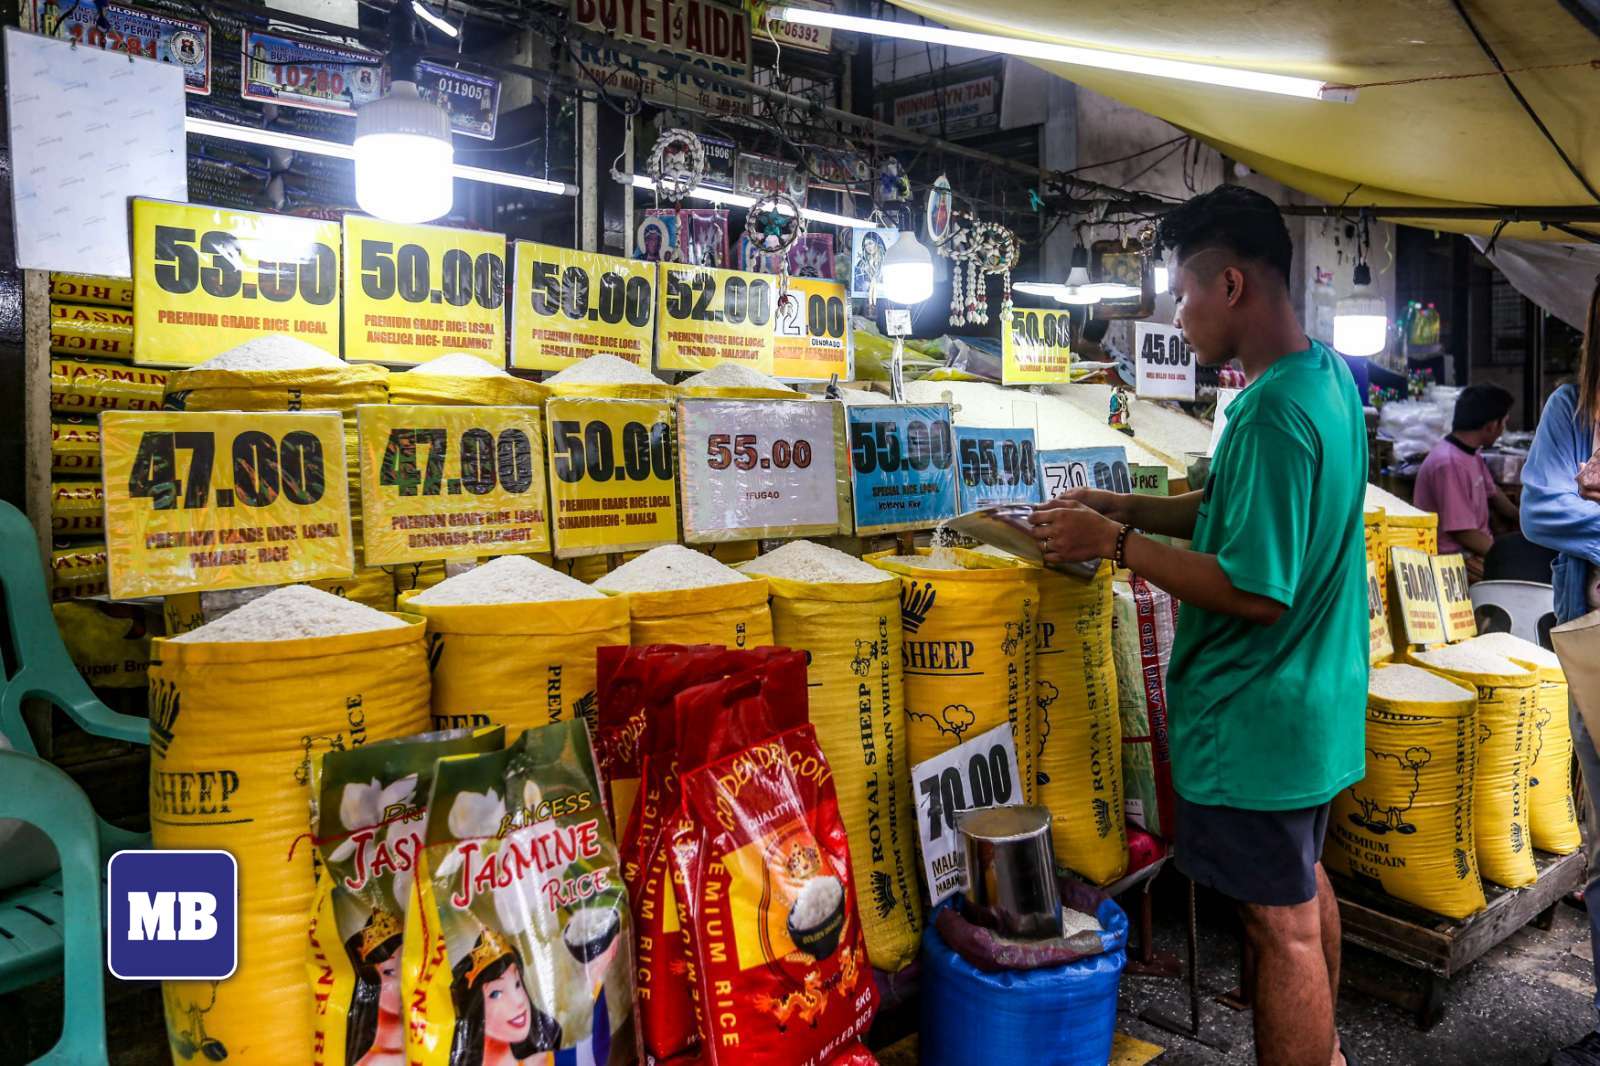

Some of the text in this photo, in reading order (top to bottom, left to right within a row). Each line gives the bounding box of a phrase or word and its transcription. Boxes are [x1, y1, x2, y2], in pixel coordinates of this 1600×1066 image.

[123, 24, 161, 40] PERMIT
[686, 3, 748, 65] AIDA
[438, 78, 483, 100] 011905
[702, 144, 730, 160] 11906
[154, 225, 337, 306] 53.00
[361, 239, 504, 310] 50.00
[531, 260, 651, 328] 50.00
[666, 269, 771, 326] 52.00
[158, 310, 328, 334] PREMIUM GRADE RICE LOCAL
[364, 313, 495, 335] PREMIUM GRADE RICE LOCAL
[367, 330, 414, 346] ANGELICA
[442, 335, 493, 350] MALAMBOT
[532, 328, 641, 350] PREMIUM GRADE RICE LOCAL
[667, 331, 703, 344] PREMIUM
[728, 335, 744, 346] RICE
[1141, 332, 1191, 367] 45.00
[380, 427, 533, 497] 47.00
[552, 420, 673, 484] 50.00
[707, 434, 812, 471] 55.00
[849, 420, 951, 474] 55.00
[959, 439, 1036, 487] 55.00
[128, 430, 326, 511] 47.00
[391, 513, 446, 530] PREMIUM
[485, 510, 510, 526] RICE
[514, 509, 545, 523] LOCAL
[560, 495, 671, 513] PREMIUM GRADE RICE LOCAL
[625, 512, 657, 526] MAALSA
[145, 522, 341, 550] PREMIUM GRADE RICE LOCAL
[258, 546, 290, 564] RICE
[878, 615, 889, 656] RICE
[902, 640, 975, 670] SHEEP
[1143, 623, 1155, 657] RED
[78, 663, 119, 677] uper
[880, 660, 892, 718] WHITE
[1008, 662, 1019, 737] SHEEP
[884, 720, 895, 777] GRAIN
[1089, 721, 1105, 792] ROYAL
[1512, 696, 1527, 818] ROYAL SHEEP
[859, 682, 885, 865] ROYAL SHEEP
[1454, 782, 1465, 843] ROYAL
[452, 818, 602, 909] JASMINE
[1364, 850, 1407, 868] GRAIN
[542, 866, 611, 913] RICE
[636, 936, 653, 1000] RICE
[714, 980, 739, 1047] RICE
[855, 986, 872, 1012] 5KG
[855, 1005, 872, 1031] RICE
